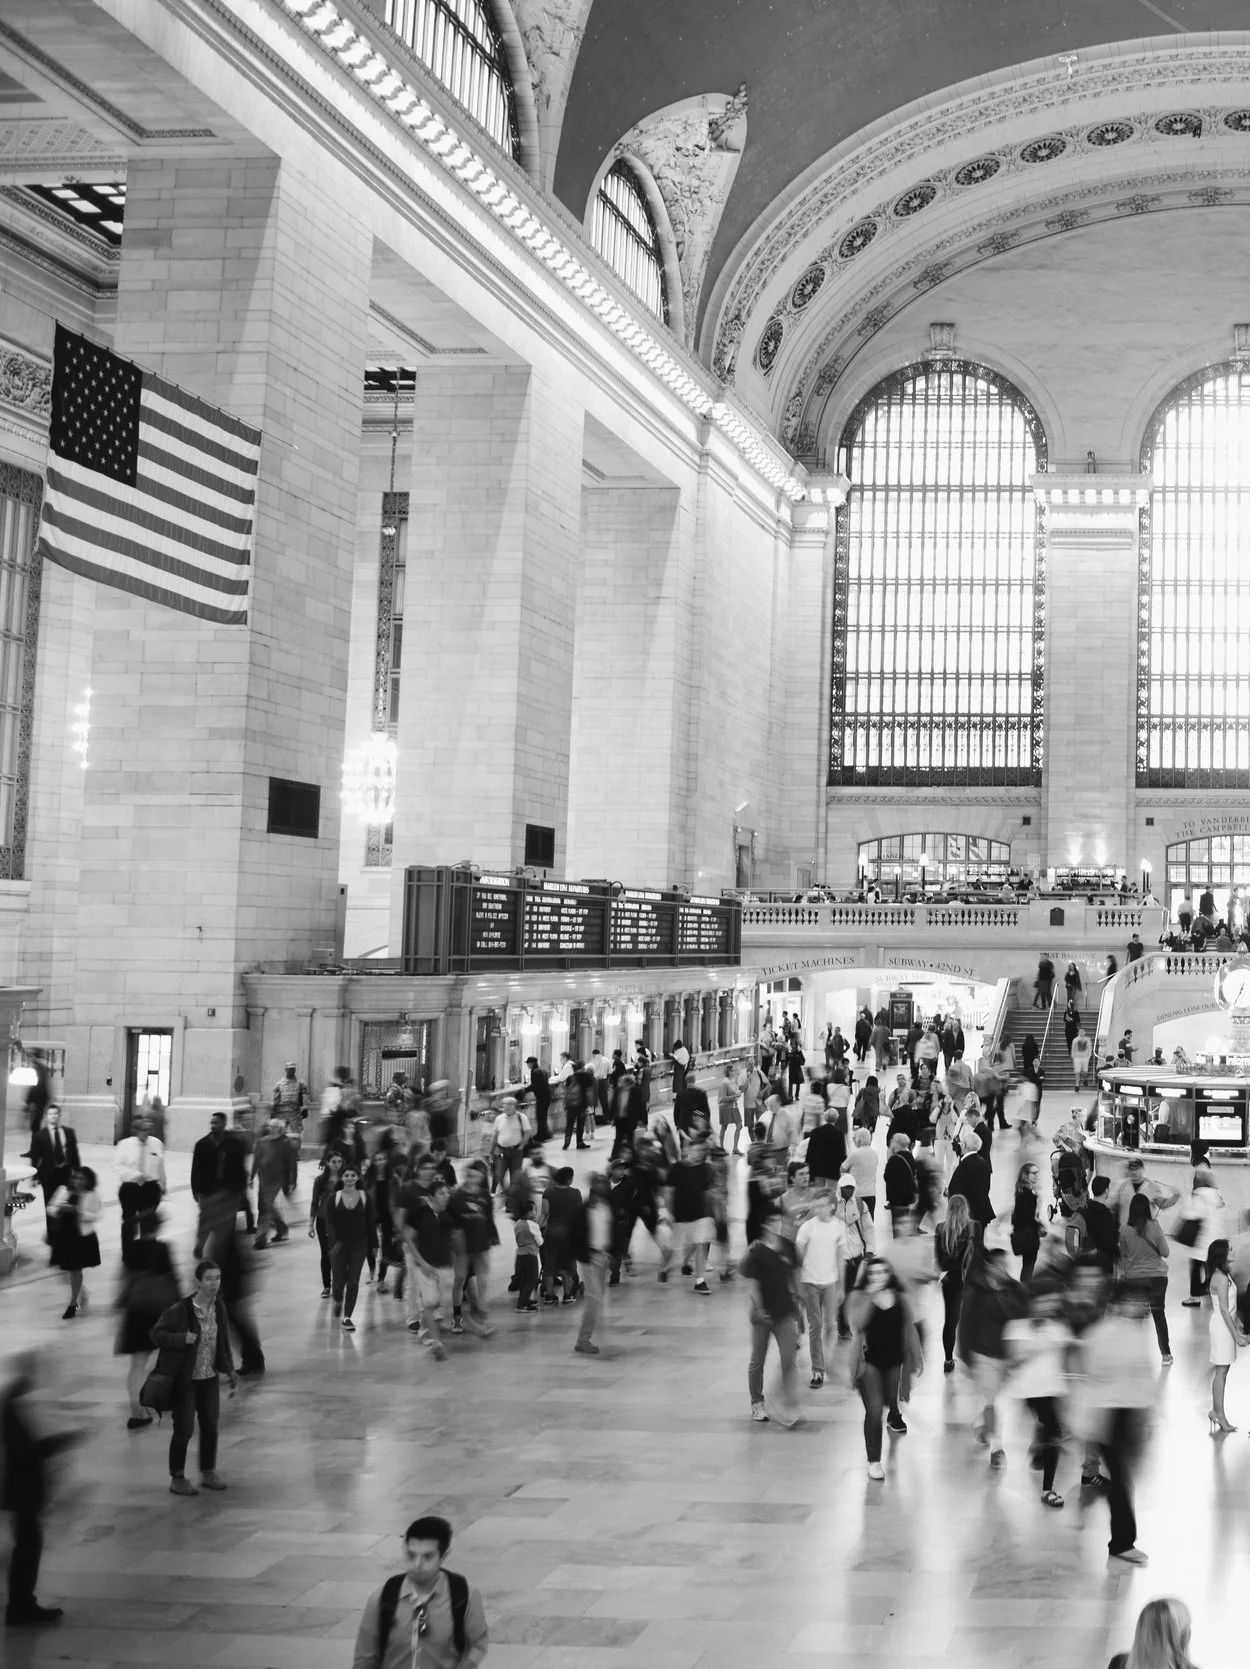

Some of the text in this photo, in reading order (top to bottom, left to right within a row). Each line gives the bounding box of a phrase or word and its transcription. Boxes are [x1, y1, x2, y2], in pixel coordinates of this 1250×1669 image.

[1174, 828, 1197, 839] THE
[1199, 824, 1249, 834] CAMPBELL
[1183, 820, 1196, 829] TO
[761, 956, 855, 976] TICKET MACHINES
[888, 957, 976, 976] SUBWAY 42ND ST
[1156, 1009, 1183, 1022] DINING
